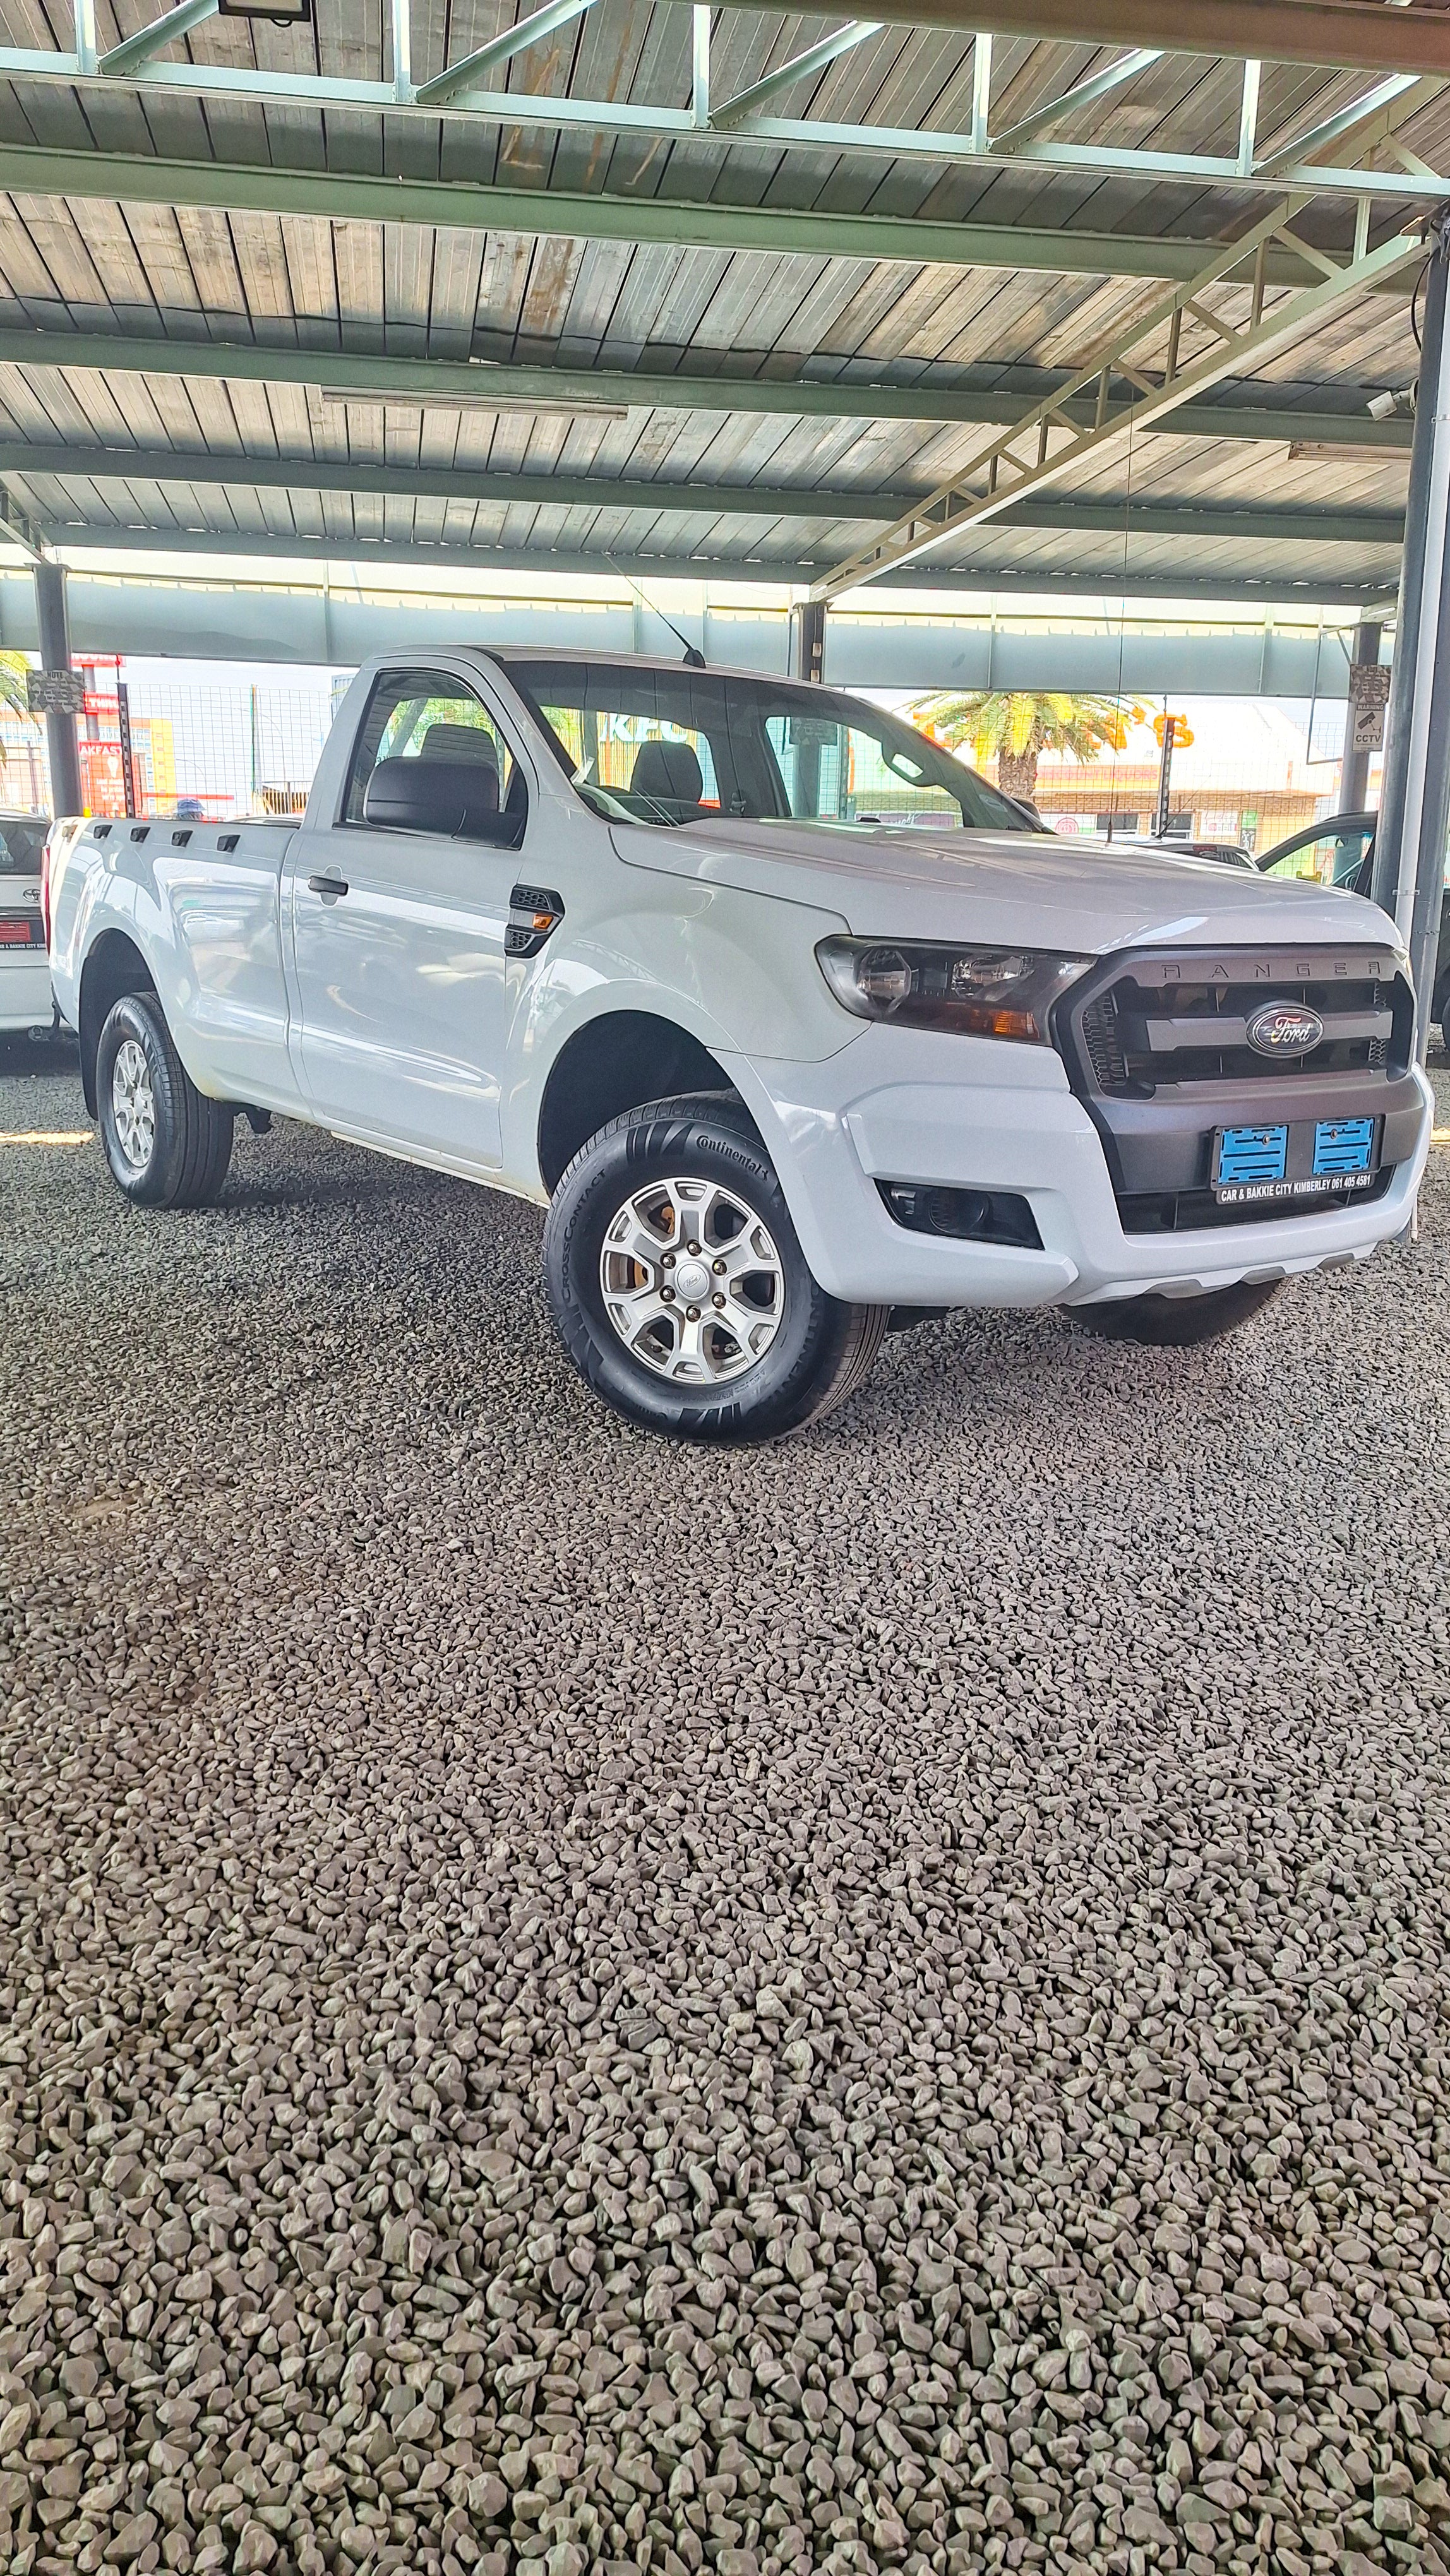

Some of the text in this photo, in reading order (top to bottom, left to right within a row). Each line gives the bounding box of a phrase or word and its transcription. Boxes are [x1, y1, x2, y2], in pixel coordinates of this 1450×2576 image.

[47, 671, 63, 679] NOTE
[599, 712, 687, 743] KFC
[1355, 734, 1381, 742] CCTV
[1161, 961, 1381, 979] RANGER
[1270, 1017, 1310, 1043] Ford
[696, 1135, 763, 1175] Continental
[1221, 1174, 1371, 1202] CAR & BAKKIE CITY KIMBERLEY 061 405 4581
